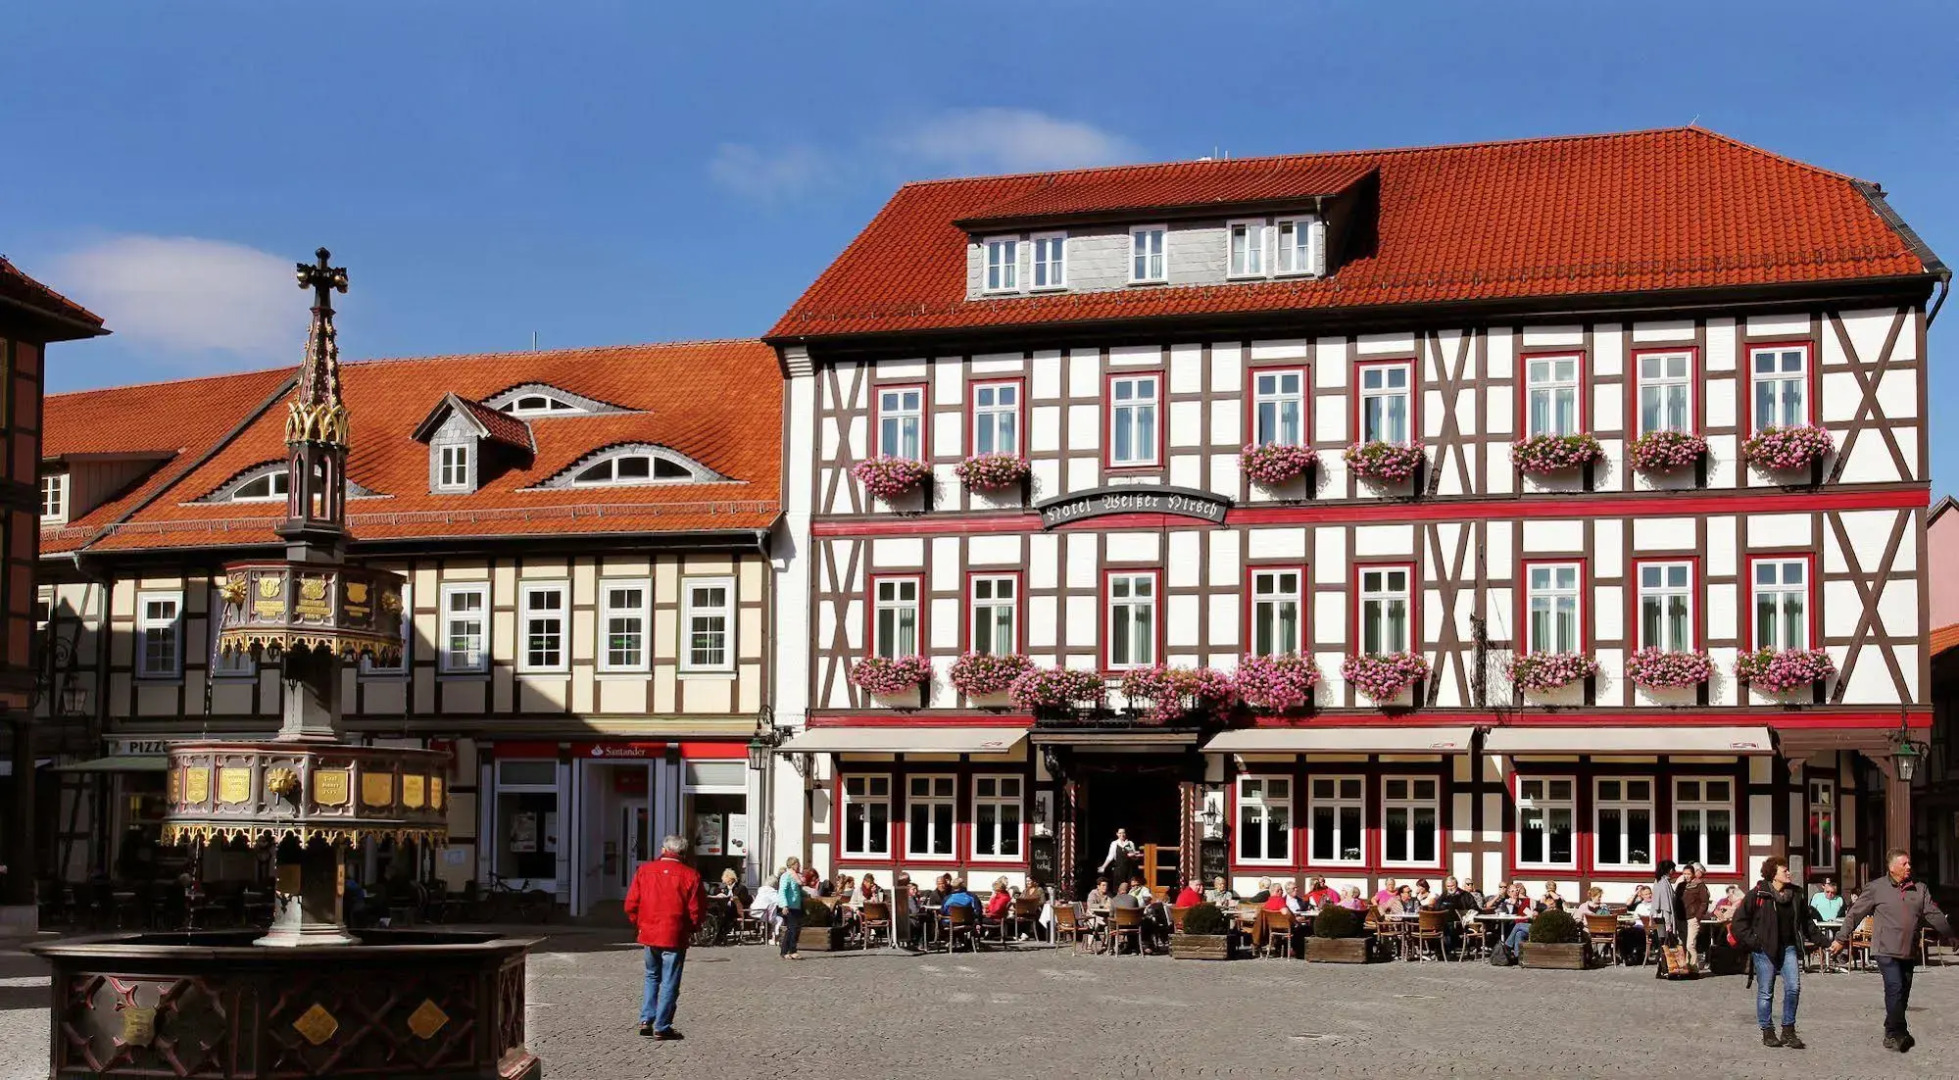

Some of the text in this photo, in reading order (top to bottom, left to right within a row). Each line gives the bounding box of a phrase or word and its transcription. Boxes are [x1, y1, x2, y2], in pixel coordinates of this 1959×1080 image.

[1046, 493, 1218, 521] Hotel Weißer Hirsch
[605, 746, 646, 756] Santander
